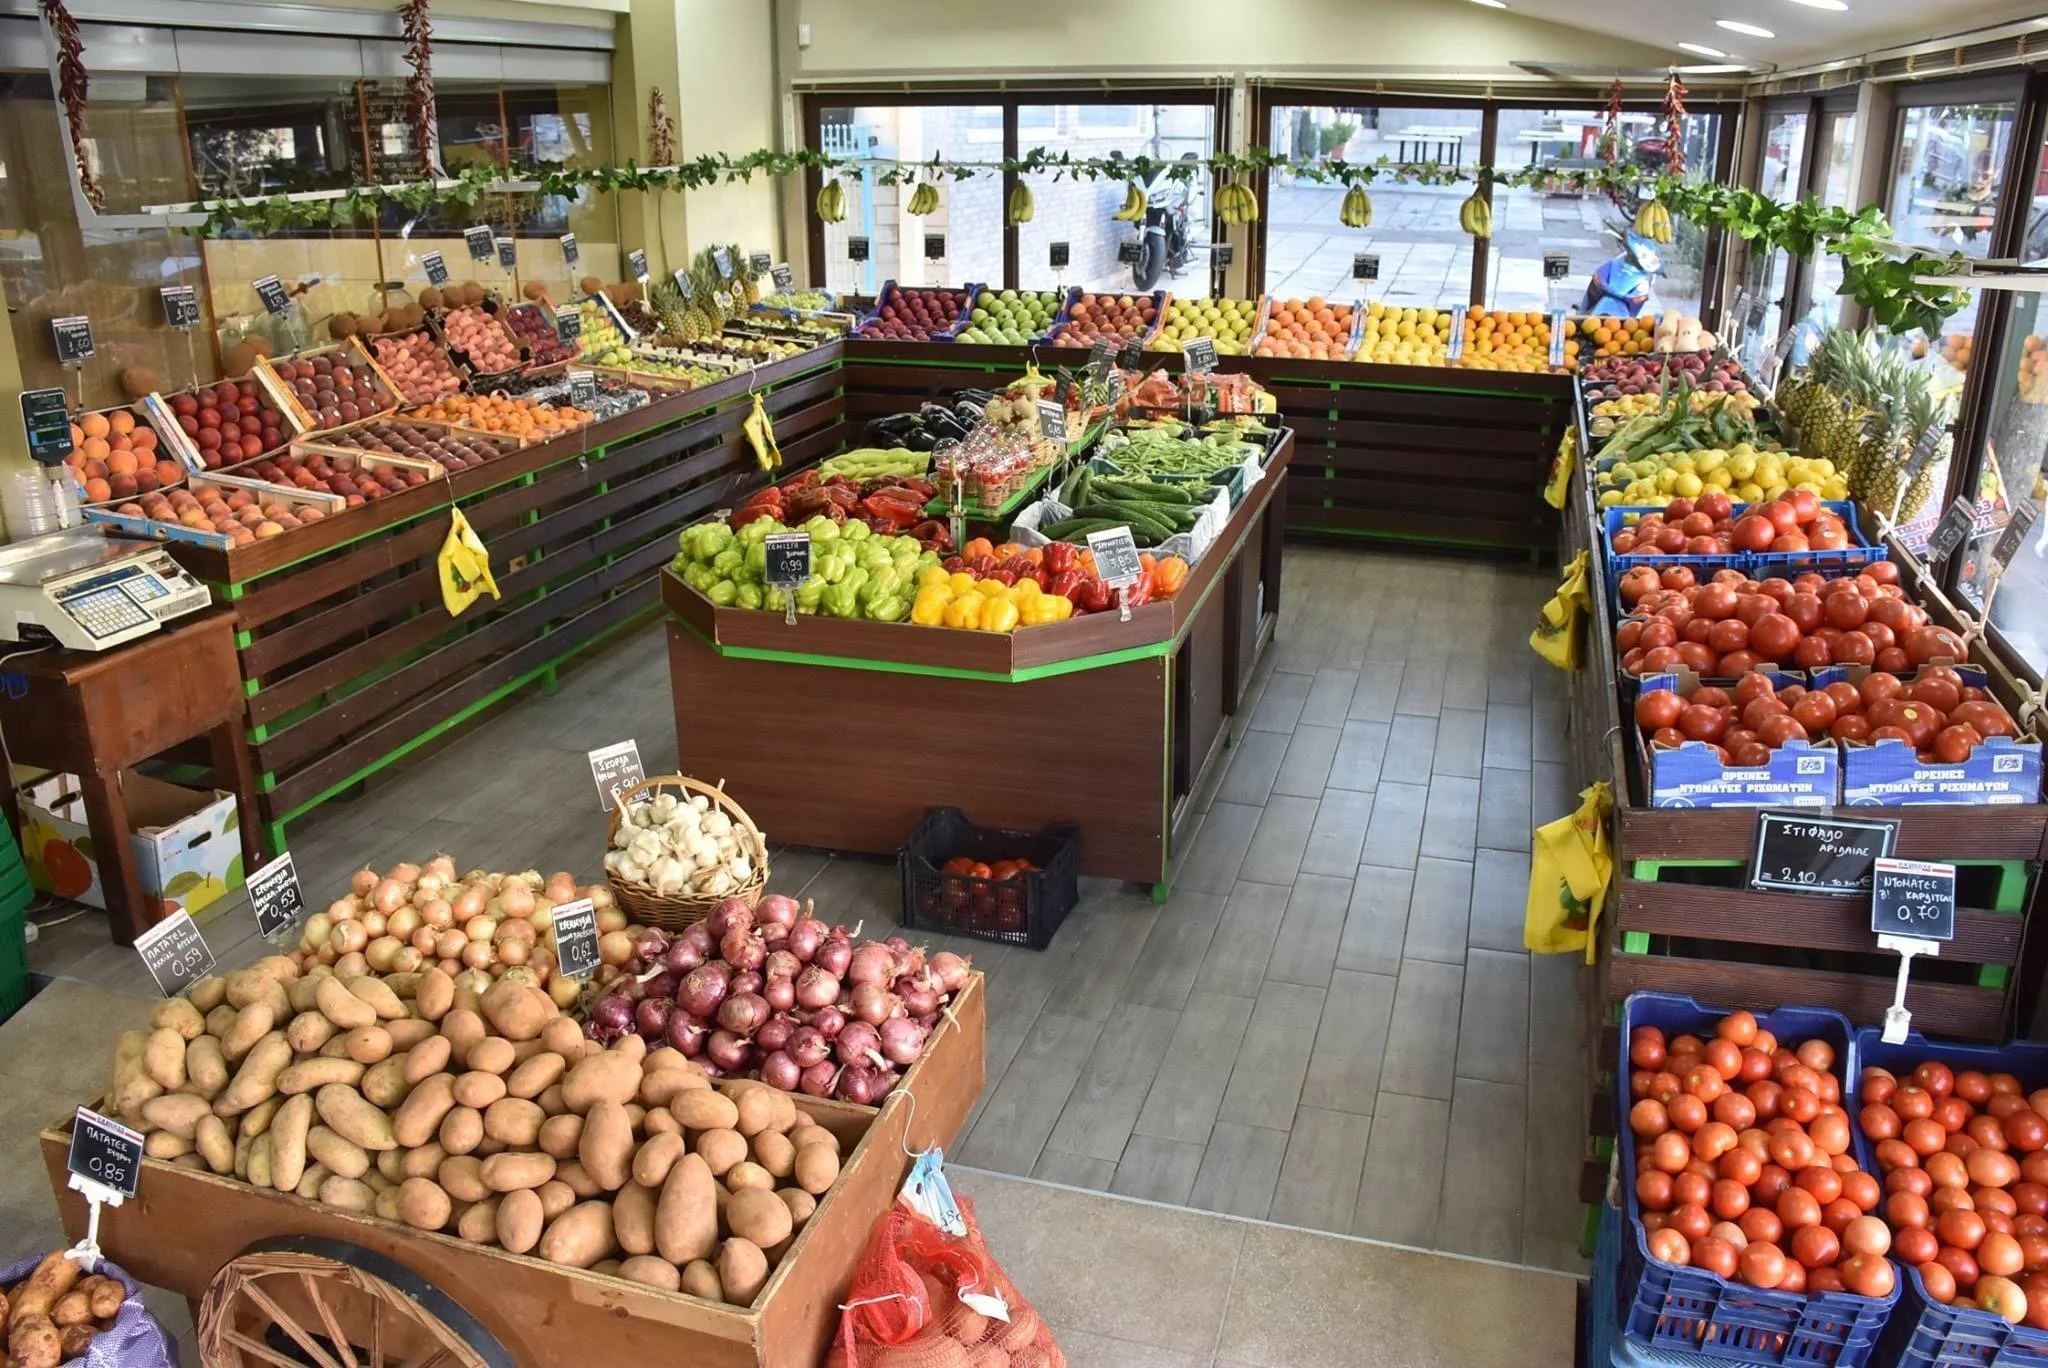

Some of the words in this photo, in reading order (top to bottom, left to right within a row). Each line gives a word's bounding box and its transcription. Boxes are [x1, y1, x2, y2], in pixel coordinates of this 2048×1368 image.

[780, 560, 802, 572] 0,99
[597, 755, 630, 772] ΣΚΟΡΔΑ
[1721, 771, 1771, 781] ΟΡΕΙΝΕΣ
[1914, 770, 1965, 780] ΟΡΕΙΝΕΣ
[1679, 783, 1741, 793] ΝΤΟΜΑΤΕΣ
[1746, 783, 1812, 793] ΡΙΖΩΜΑΤΩΝ
[1868, 783, 1934, 793] ΝΤΟΜΑΤΕΣ
[1939, 782, 2009, 792] ΡΙΖΩΜΑΤΩΝ
[1884, 876, 1937, 890] ΝΤΟΜΑΤΕΣ
[1897, 905, 1940, 924] 0,70
[147, 929, 186, 959] ΠΑΤΑΤΕΣ
[172, 947, 203, 977] 0,59
[86, 1126, 129, 1152] ΠΑΤΑΤΕΣ
[89, 1157, 126, 1181] 0,85
